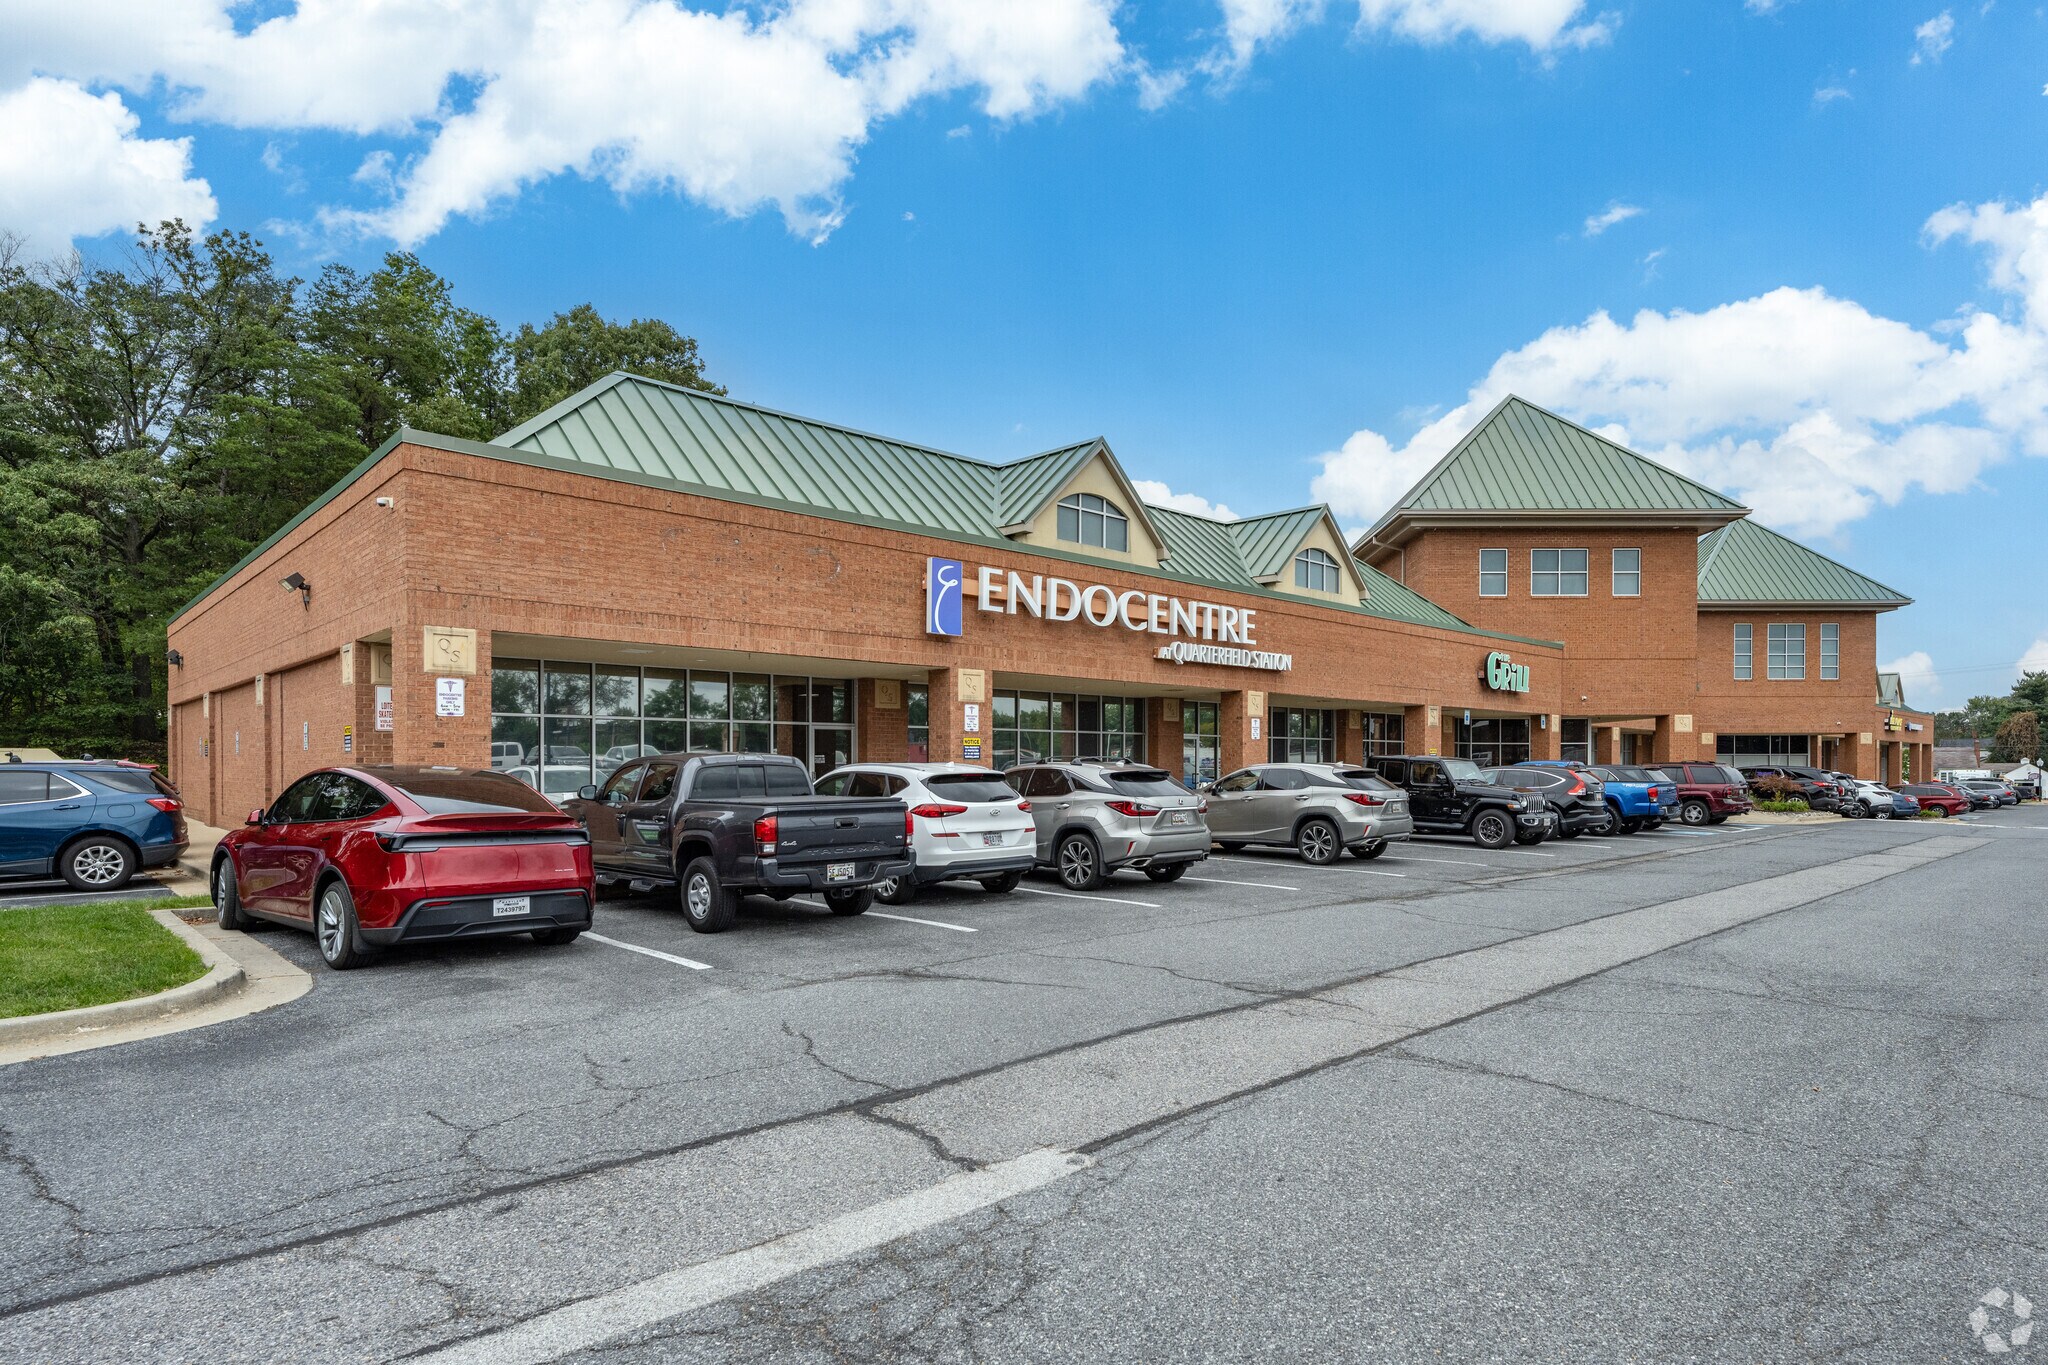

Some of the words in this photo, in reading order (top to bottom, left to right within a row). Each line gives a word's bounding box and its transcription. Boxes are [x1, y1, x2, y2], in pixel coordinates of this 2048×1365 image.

[978, 567, 1256, 645] ENDOCENTRE
[1158, 647, 1171, 660] AT
[1169, 641, 1251, 668] QUARTERFIELD
[1250, 651, 1292, 671] STATION
[807, 845, 881, 856] TACOMA
[496, 905, 526, 914] T2439797
